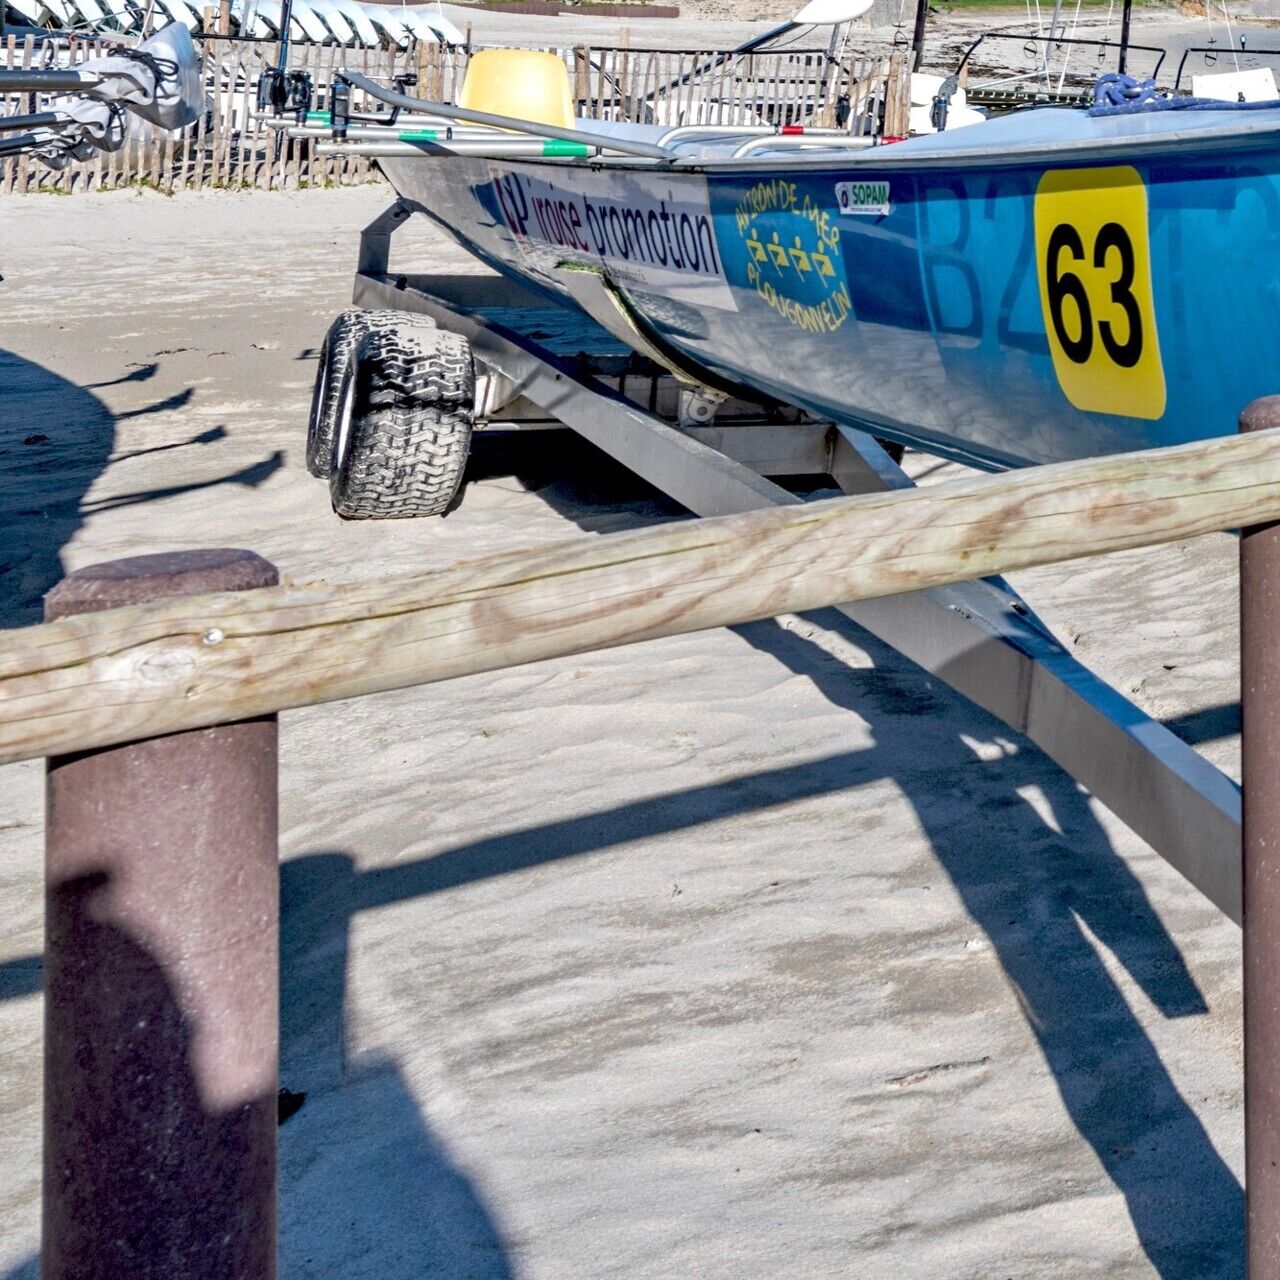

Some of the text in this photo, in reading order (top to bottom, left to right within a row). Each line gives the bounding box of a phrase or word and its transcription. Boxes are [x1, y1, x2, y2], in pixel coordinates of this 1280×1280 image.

[736, 178, 841, 257] AVIRON DE MER
[852, 184, 887, 205] SOPAM
[746, 261, 853, 334] PLOUGONVELIN
[1046, 222, 1143, 368] 63
